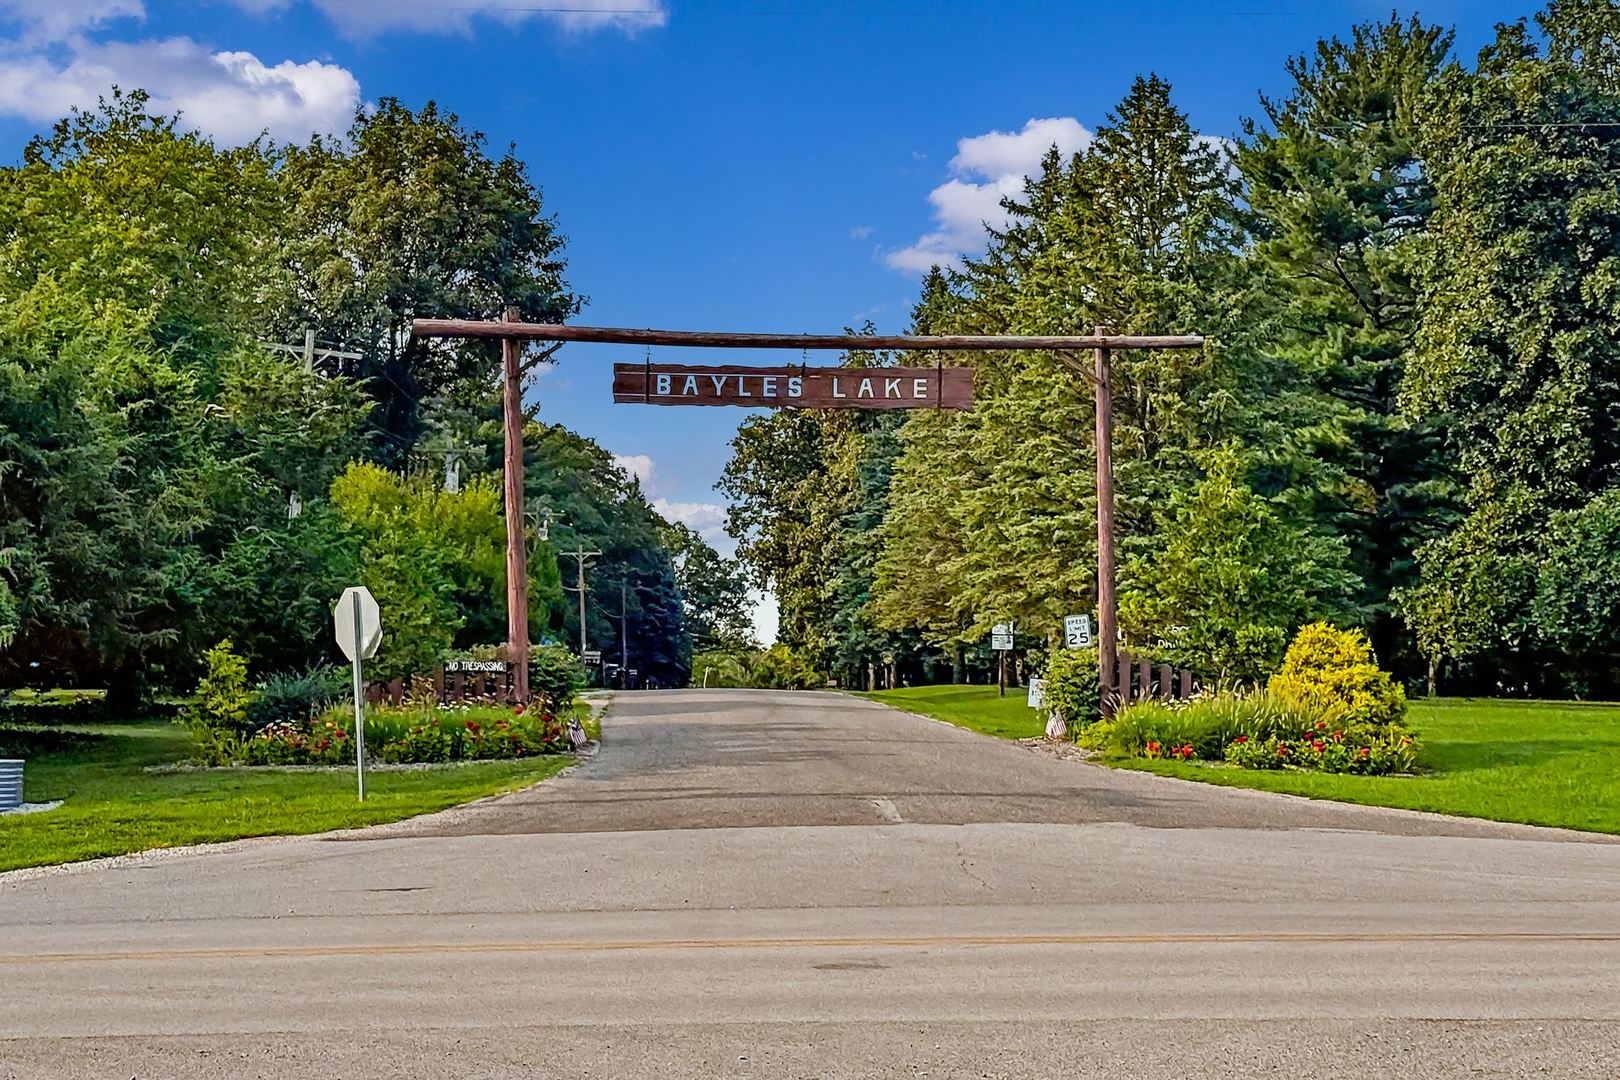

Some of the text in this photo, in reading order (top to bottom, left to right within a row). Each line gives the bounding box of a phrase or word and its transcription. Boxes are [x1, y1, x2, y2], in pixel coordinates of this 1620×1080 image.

[656, 374, 928, 399] BAYLES LAKE
[1068, 632, 1089, 645] 25
[445, 661, 505, 671] NO TRESPASSING
